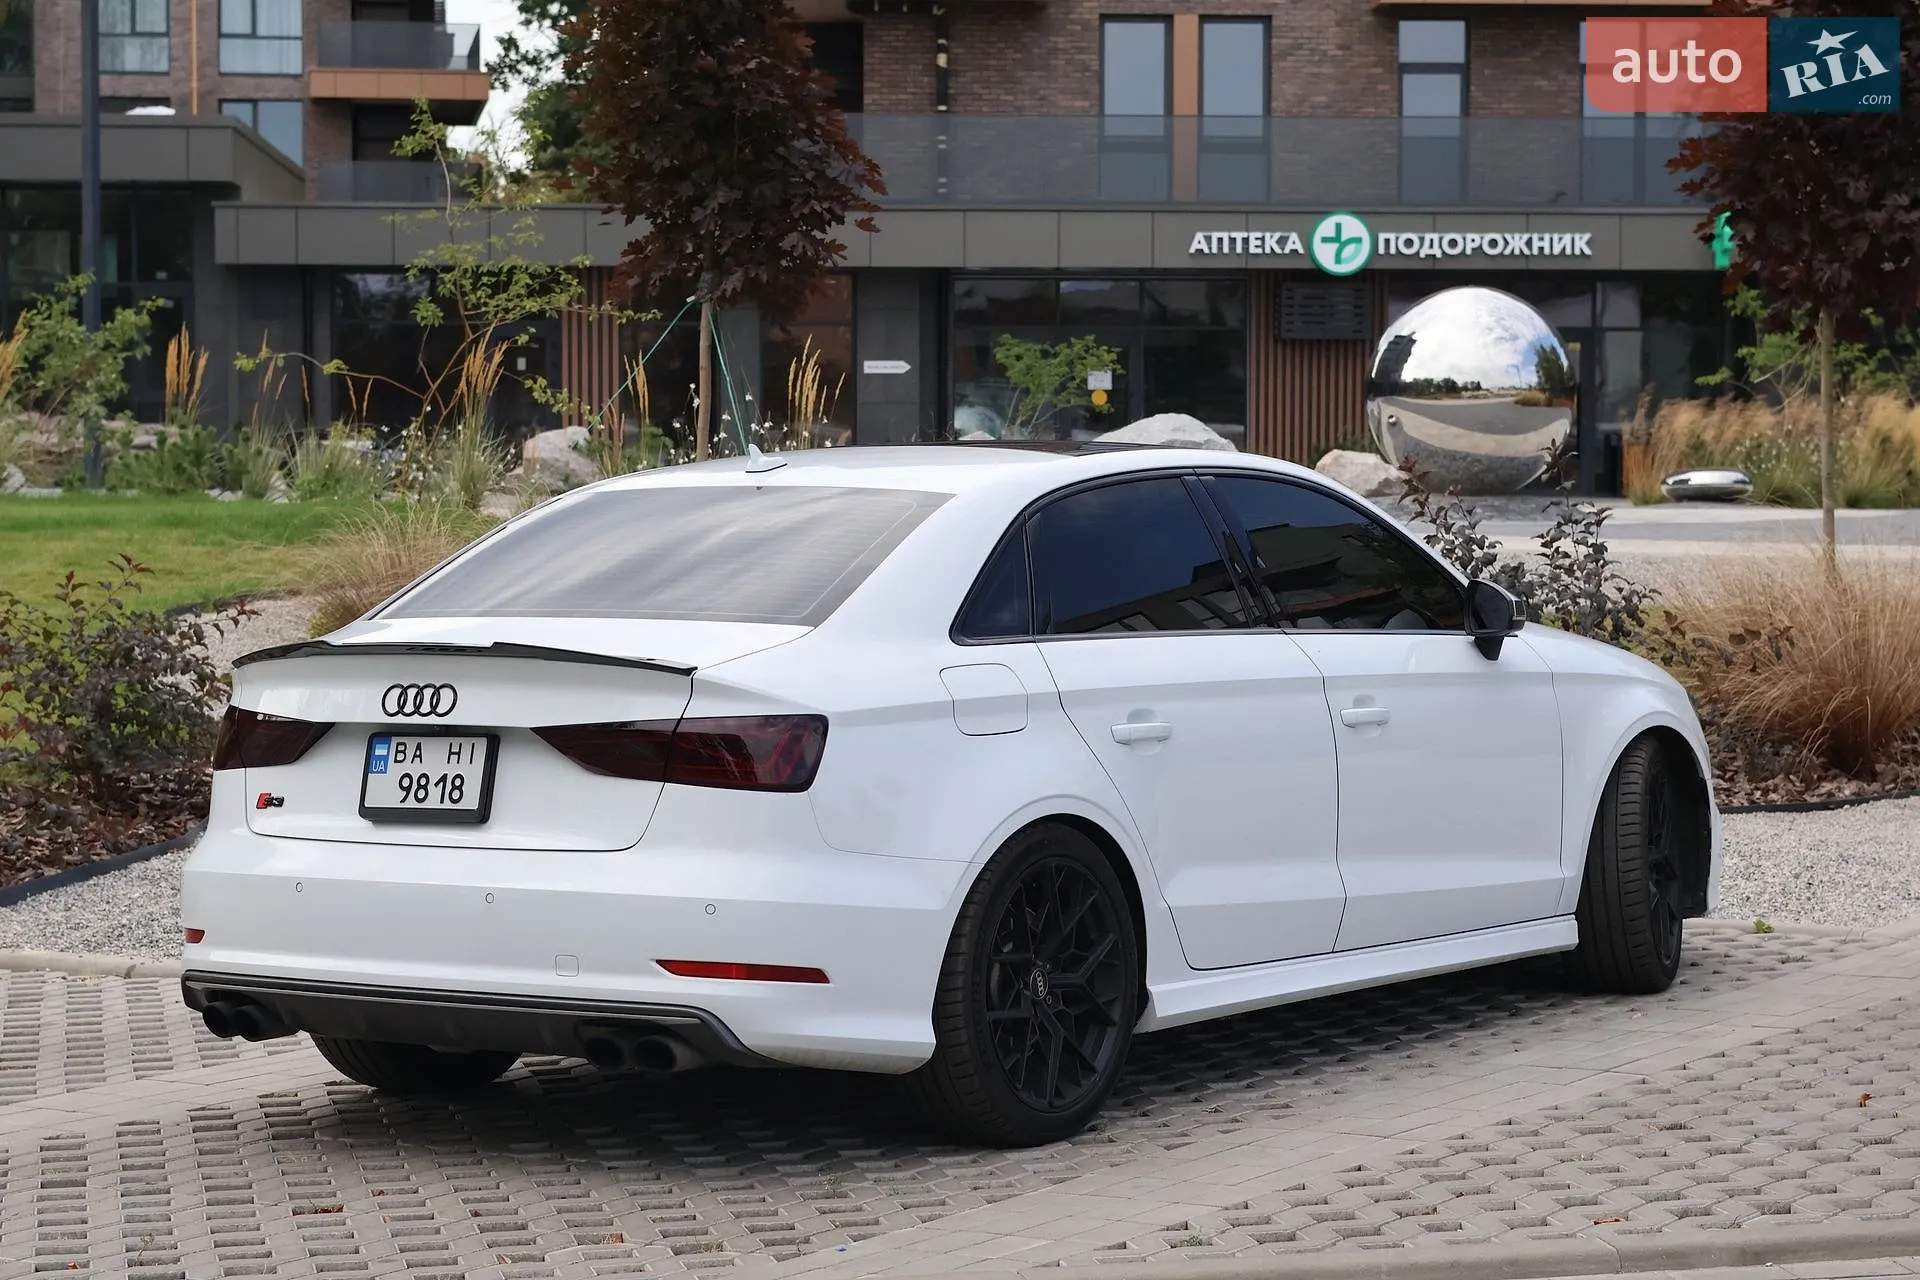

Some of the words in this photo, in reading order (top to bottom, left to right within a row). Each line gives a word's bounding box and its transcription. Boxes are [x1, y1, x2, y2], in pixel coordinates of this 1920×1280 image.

[1189, 231, 1304, 255] АПТЕКА
[1378, 231, 1592, 258] ПОДОРОЖНИК
[393, 741, 423, 764] BA
[447, 742, 476, 764] HI
[372, 760, 385, 772] UA
[398, 772, 465, 804] 9818
